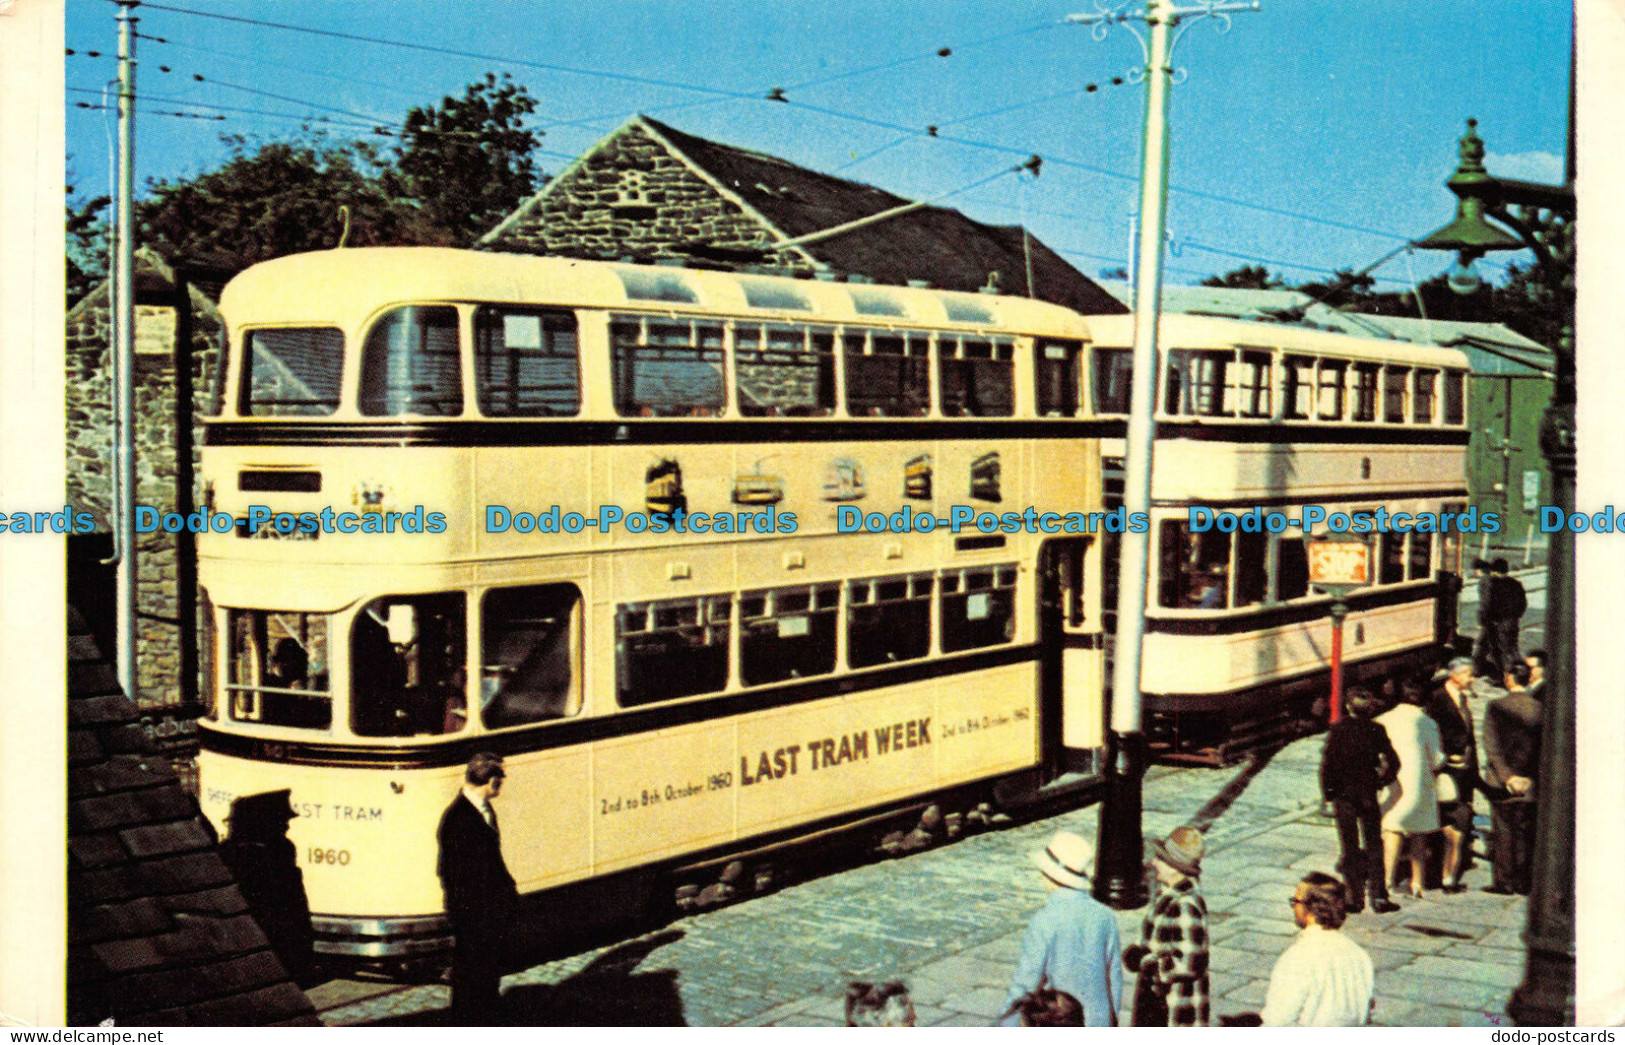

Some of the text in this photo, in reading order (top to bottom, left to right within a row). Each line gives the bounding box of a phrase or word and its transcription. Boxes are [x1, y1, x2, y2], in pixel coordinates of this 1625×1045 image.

[741, 744, 801, 786] LAST
[808, 731, 869, 771] TRAM
[874, 717, 931, 755] WEEK
[332, 805, 383, 821] TRAM
[307, 847, 351, 866] 1960
